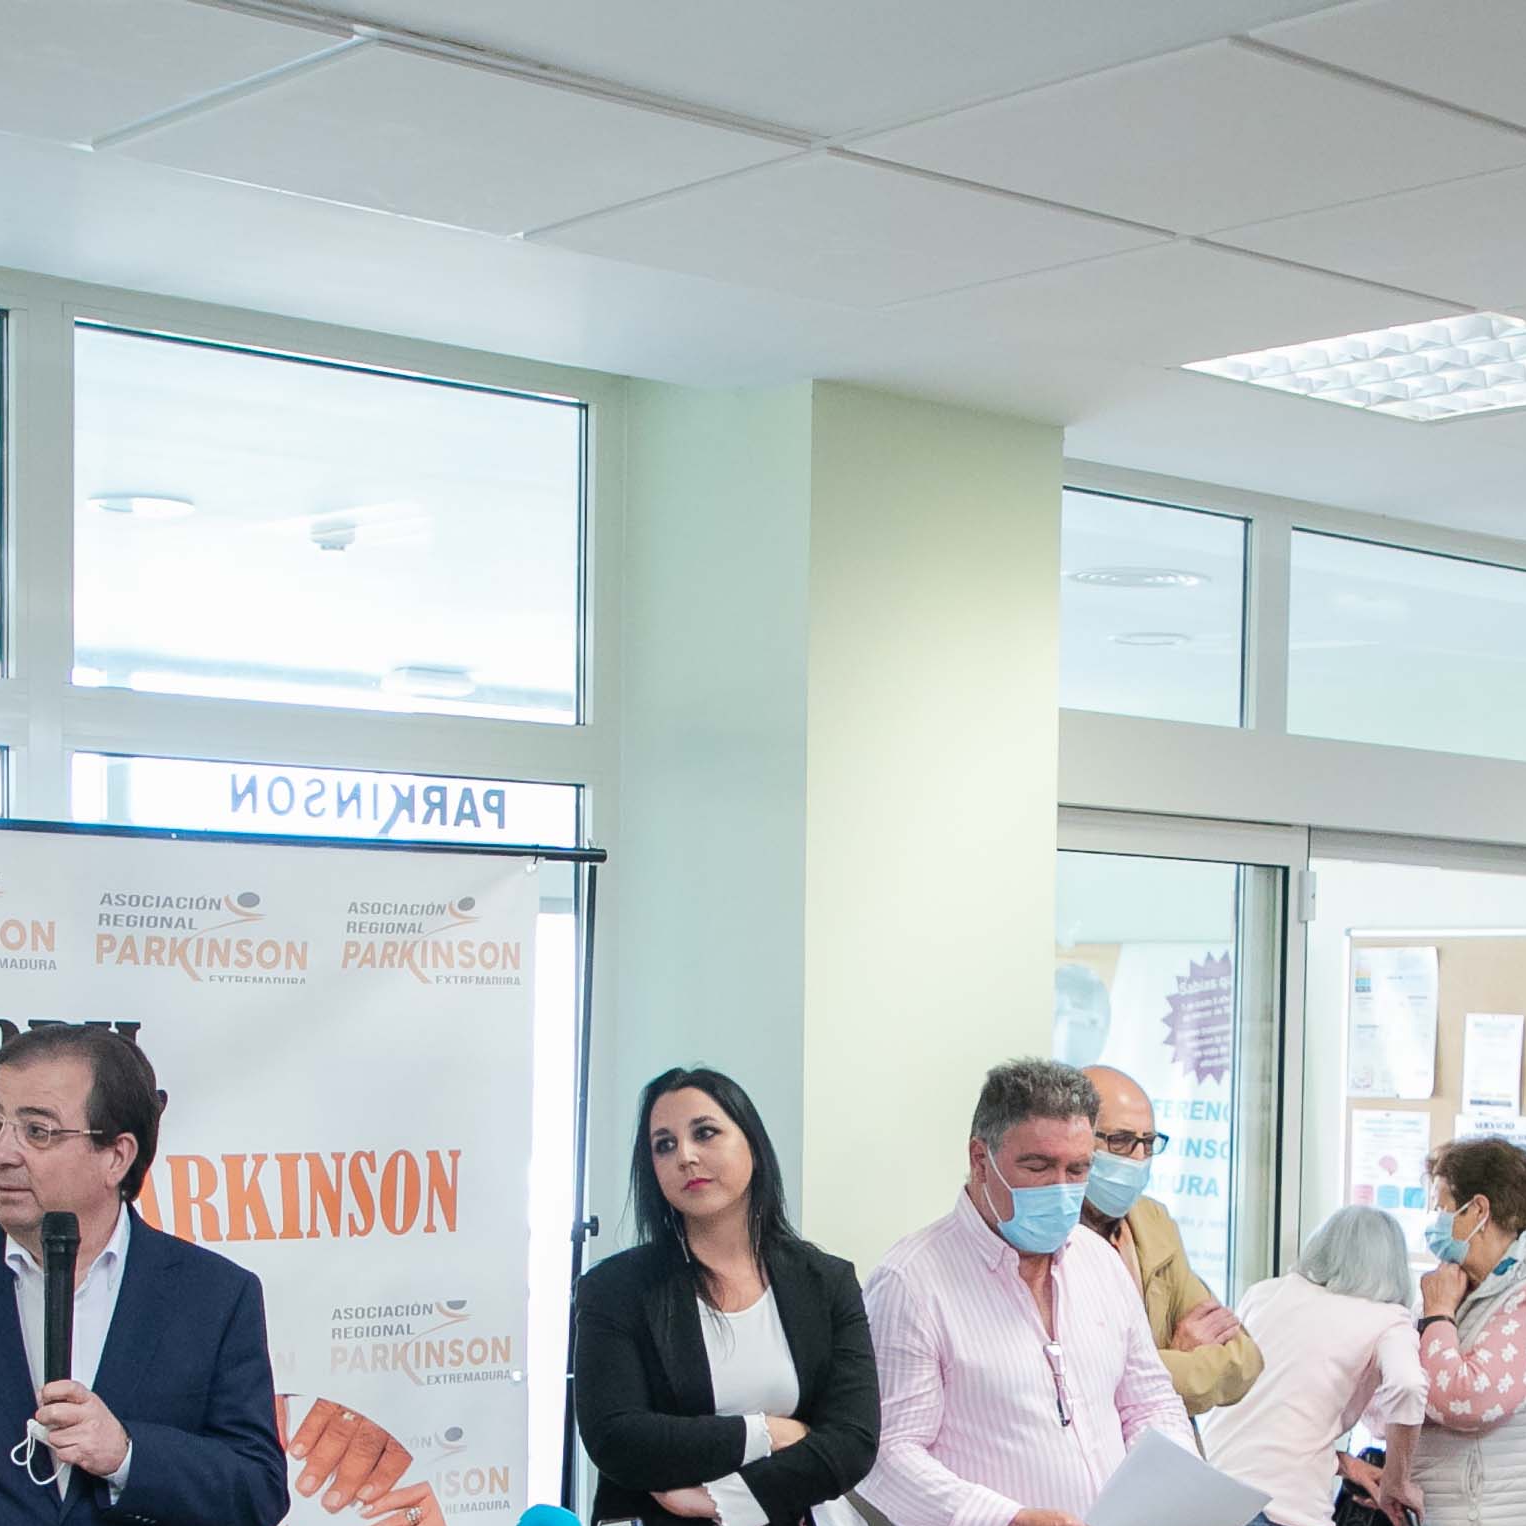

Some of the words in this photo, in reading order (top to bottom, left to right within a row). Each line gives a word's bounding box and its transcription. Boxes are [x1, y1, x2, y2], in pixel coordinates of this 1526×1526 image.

[99, 892, 222, 912] ASOCIACIÓN
[347, 901, 447, 918] ASOCIACIÓN
[97, 913, 199, 931] REGIONAL
[346, 920, 425, 935] REGIONAL
[95, 933, 309, 982] PARKINSON
[341, 940, 522, 985] PARKINSON
[331, 1303, 434, 1321] ASOCIACIÓN
[330, 1323, 416, 1340] REGIONAL
[330, 1335, 512, 1386] PARKINSON
[426, 1370, 512, 1386] EXTREMADURA
